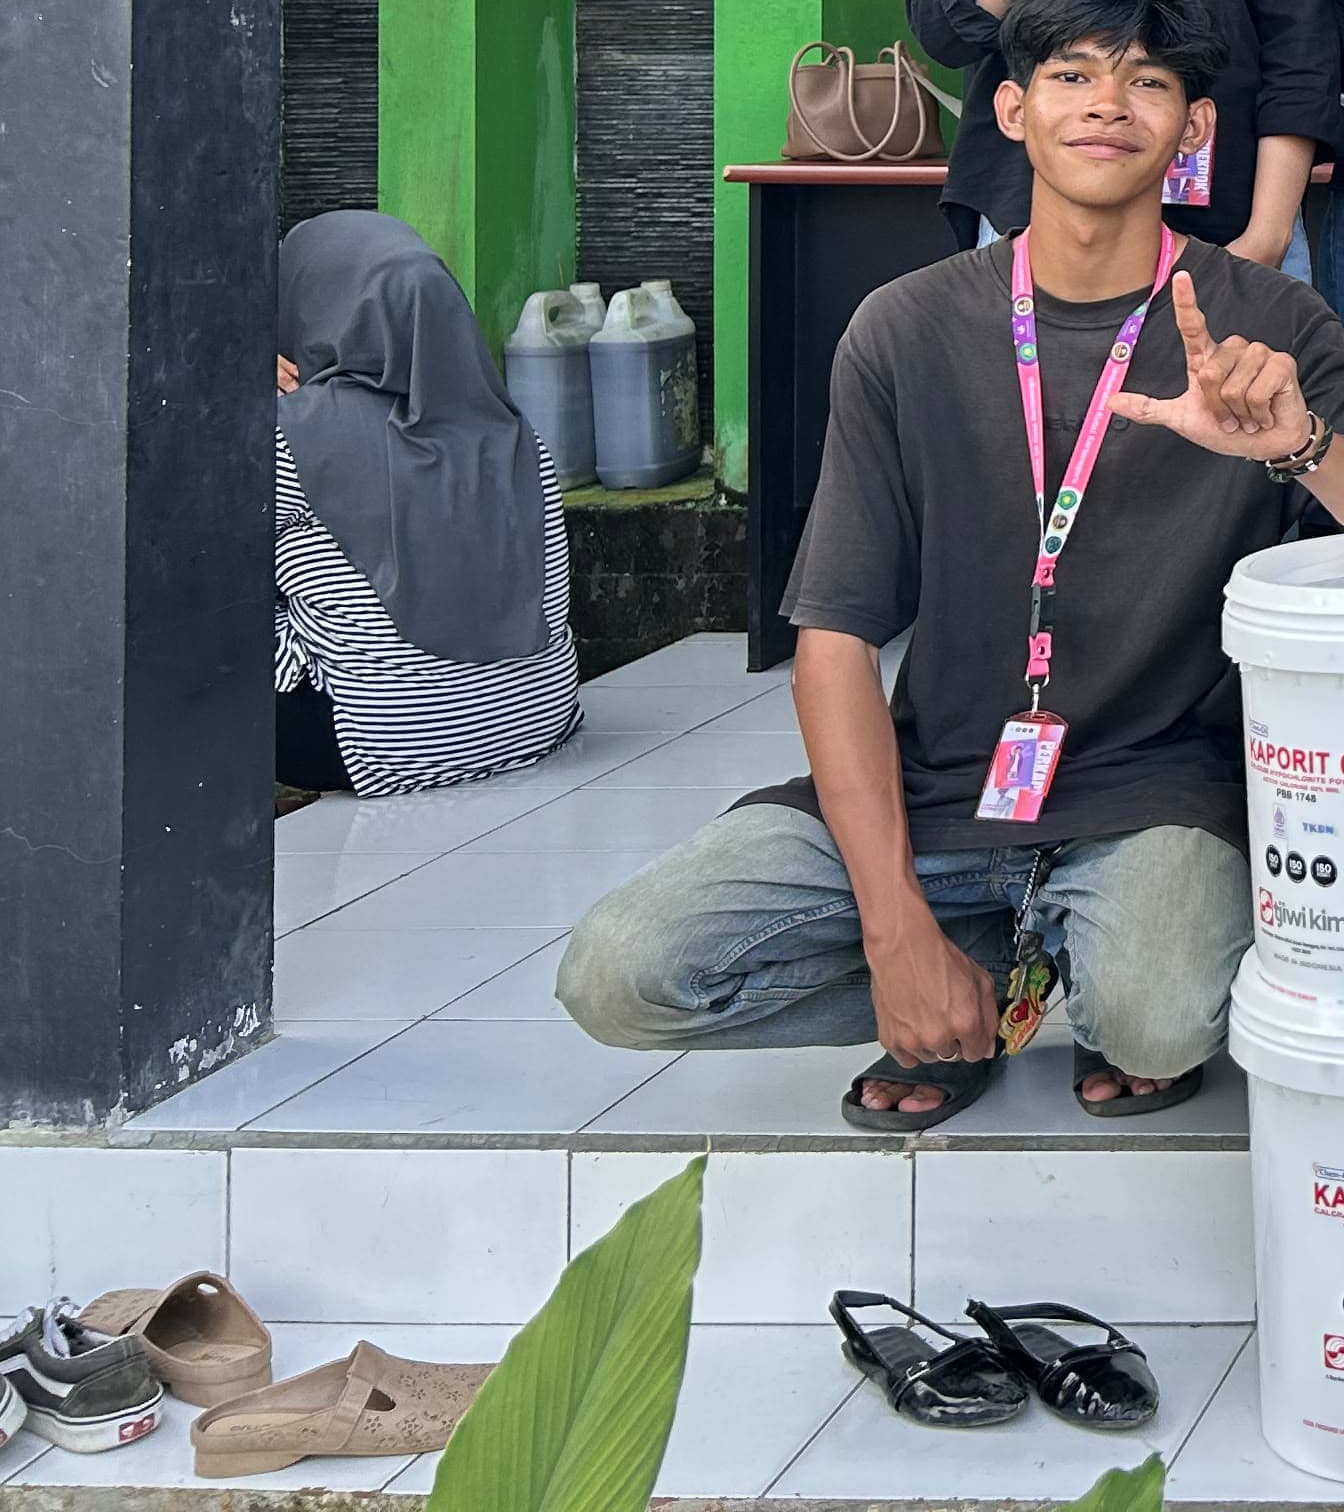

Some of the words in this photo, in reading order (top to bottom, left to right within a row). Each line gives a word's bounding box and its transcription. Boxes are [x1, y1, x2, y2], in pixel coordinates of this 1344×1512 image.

[1249, 736, 1330, 775] KAPORIT
[1295, 791, 1317, 803] 1748
[1275, 899, 1306, 930] tjiwi
